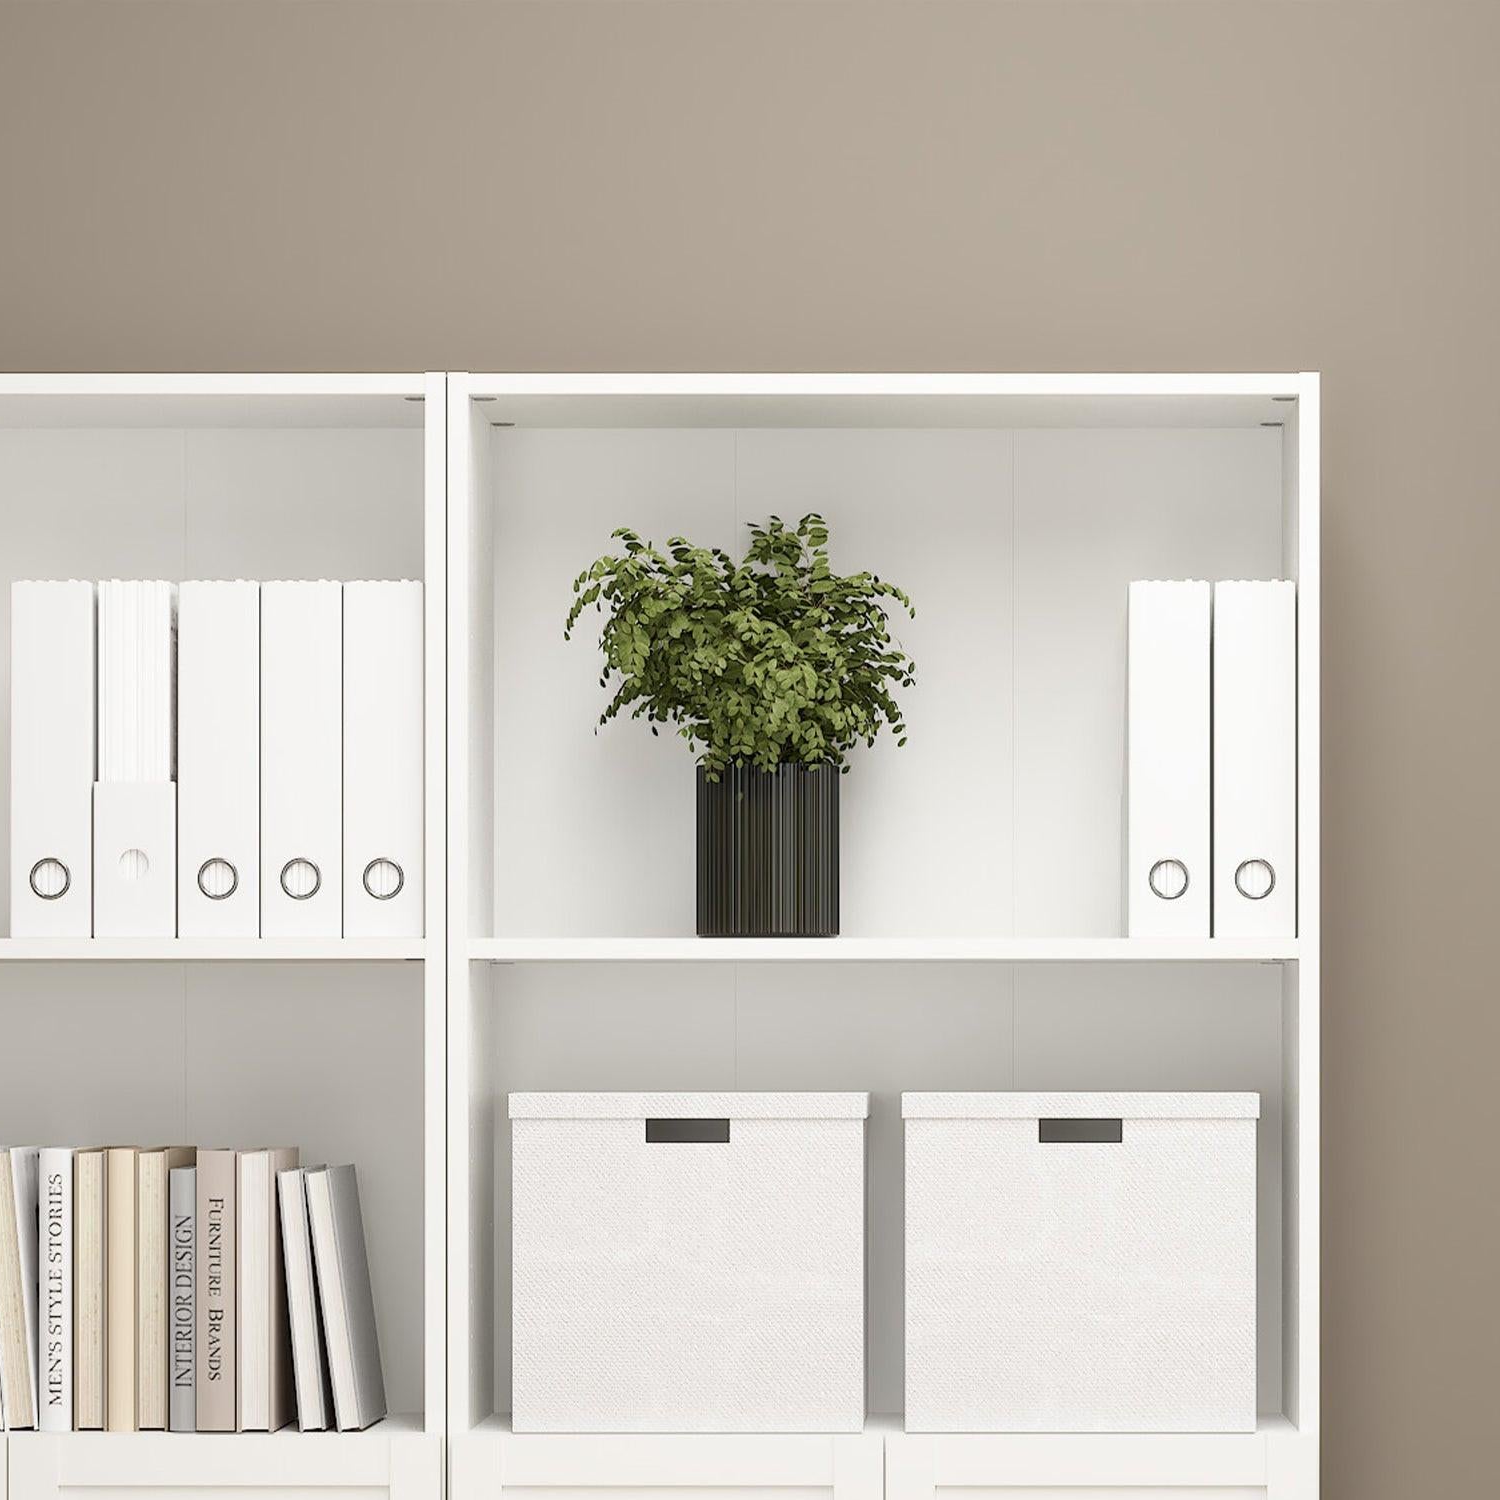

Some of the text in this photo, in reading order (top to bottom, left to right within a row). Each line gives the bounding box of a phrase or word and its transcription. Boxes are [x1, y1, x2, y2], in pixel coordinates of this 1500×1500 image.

[48, 1173, 63, 1406] MEN'S STYLE STORIES
[175, 1214, 193, 1387] INTERIOR DESIGN
[208, 1198, 224, 1381] FURNITURE BRANDS
